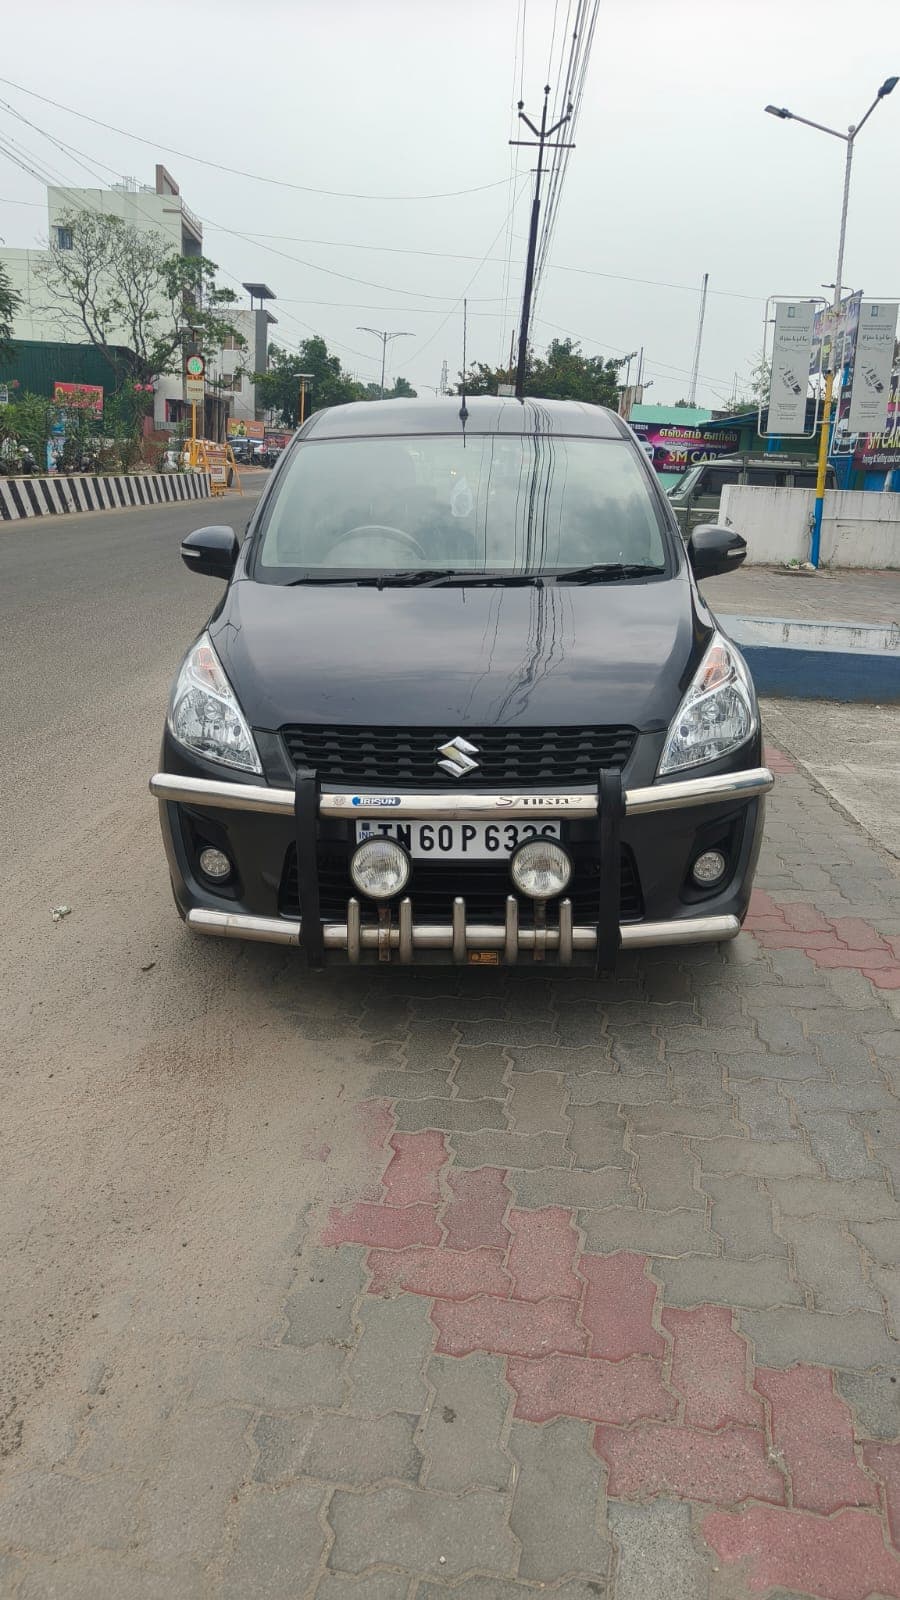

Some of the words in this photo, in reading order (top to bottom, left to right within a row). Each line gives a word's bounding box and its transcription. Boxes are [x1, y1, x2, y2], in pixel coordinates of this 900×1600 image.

[669, 450, 687, 463] SM
[378, 824, 411, 851] TN
[420, 825, 452, 851] 60
[462, 825, 476, 851] P
